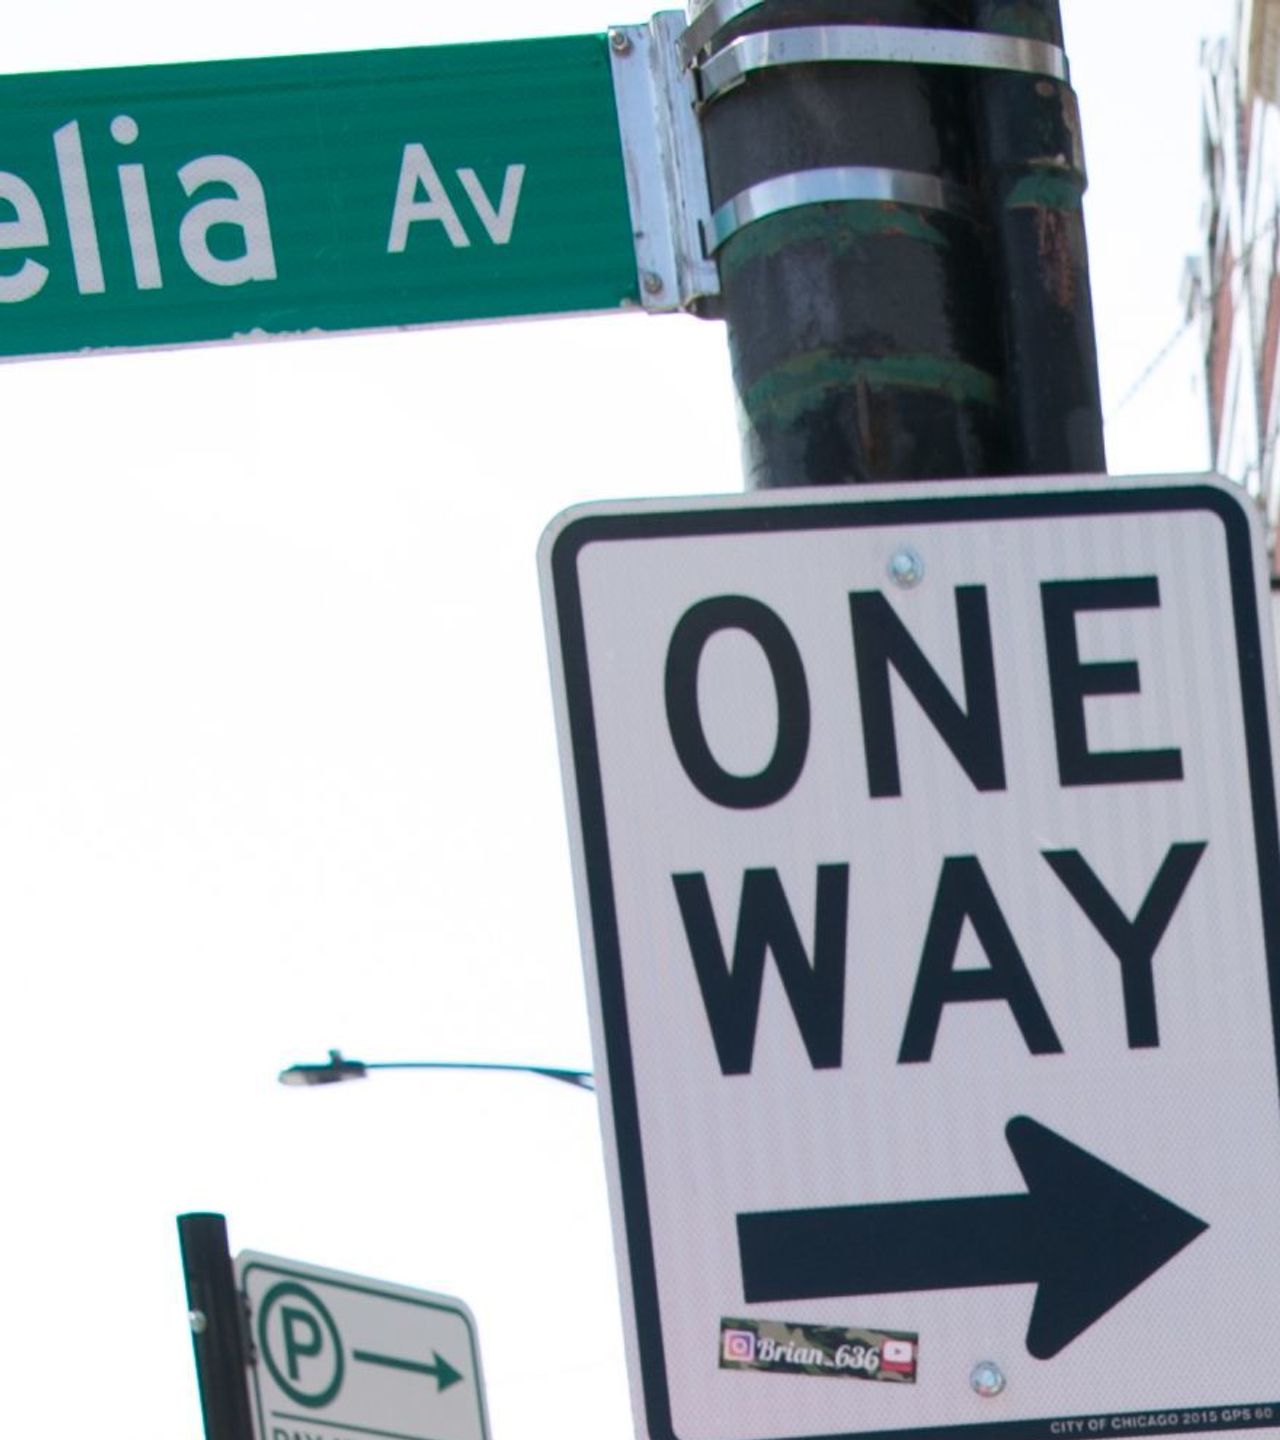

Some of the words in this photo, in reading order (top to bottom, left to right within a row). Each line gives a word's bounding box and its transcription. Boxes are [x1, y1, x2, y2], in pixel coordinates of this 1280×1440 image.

[387, 143, 526, 253] Av
[663, 575, 1184, 811] ONE
[670, 840, 1208, 1077] WAY
[281, 1305, 323, 1381] P
[756, 1337, 881, 1372] Brian_636
[1050, 1419, 1084, 1434] CITY
[1087, 1417, 1106, 1432] OF
[1110, 1413, 1179, 1430] CHICAGO
[1182, 1411, 1218, 1426] 2015
[1221, 1408, 1252, 1422] GPS
[1255, 1407, 1274, 1419] 60
